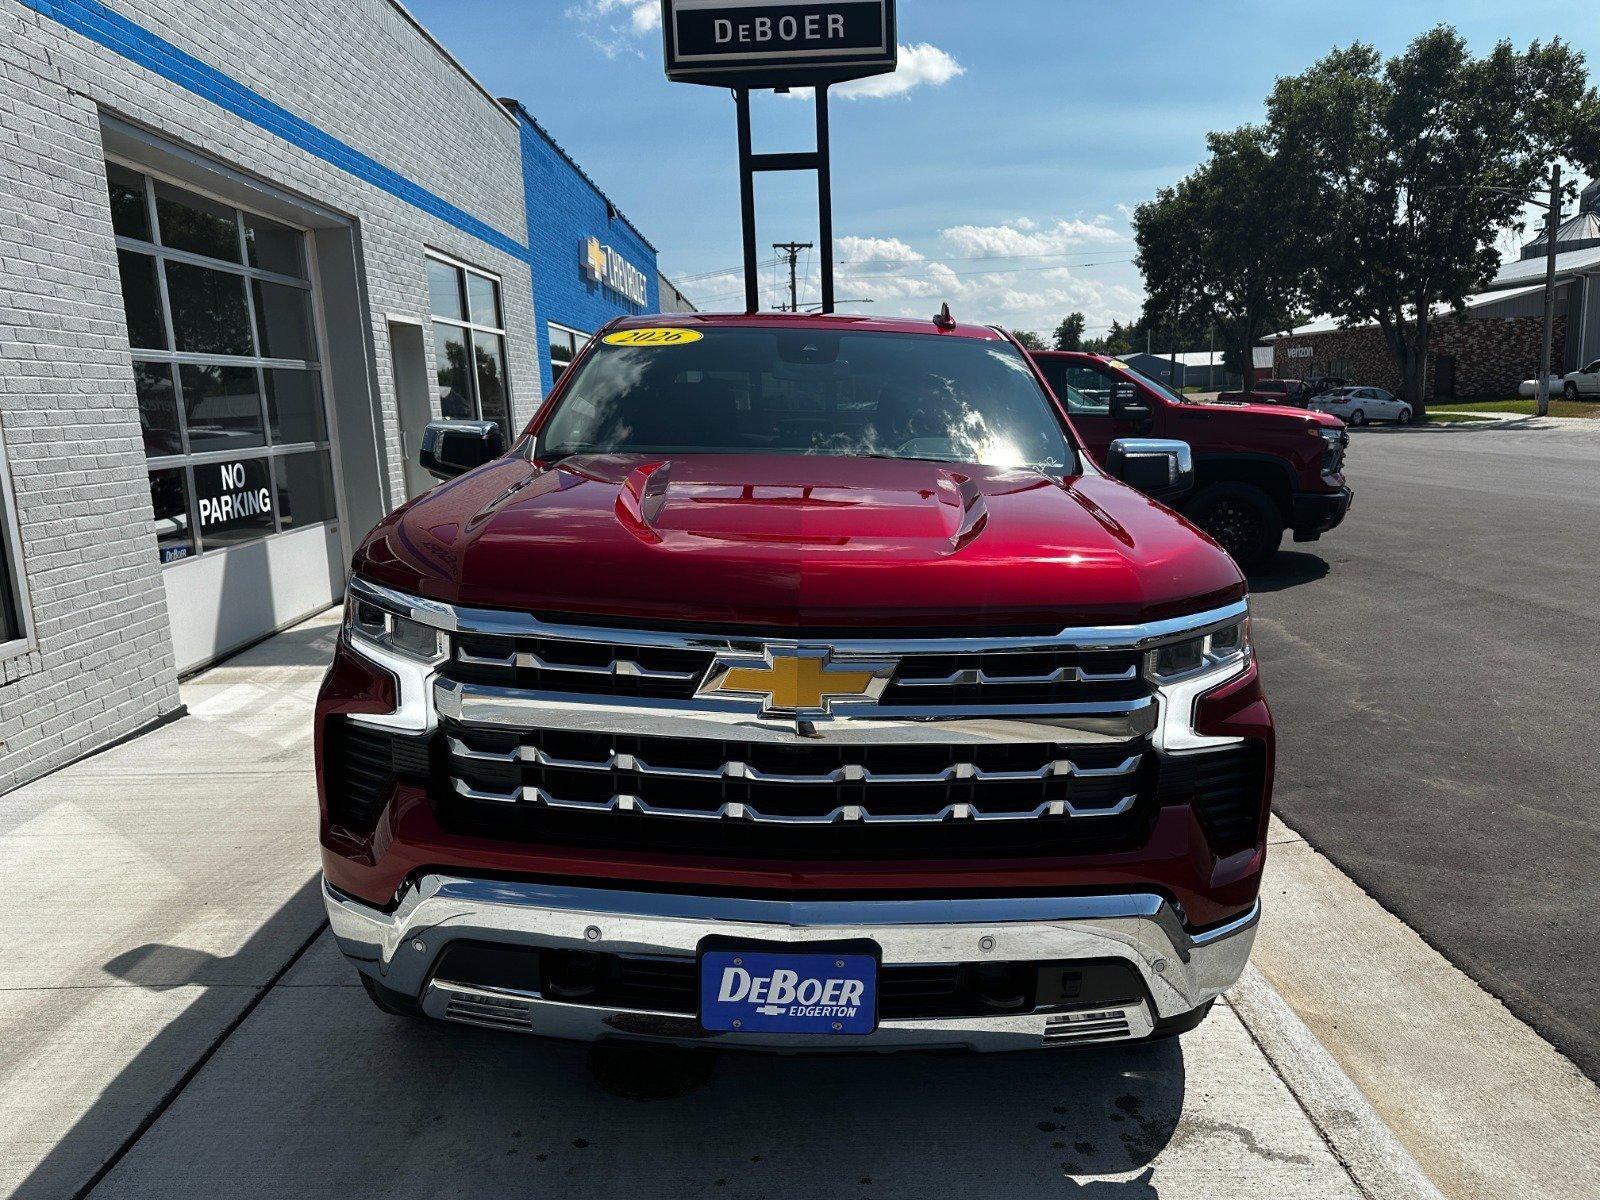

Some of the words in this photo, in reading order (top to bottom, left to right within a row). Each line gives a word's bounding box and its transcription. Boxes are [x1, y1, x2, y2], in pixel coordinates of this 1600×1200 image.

[616, 332, 683, 342] 2026
[1287, 346, 1313, 358] verizon
[221, 463, 245, 490] NO
[199, 487, 271, 526] PARKING
[789, 1006, 857, 1017] EDGERTON
